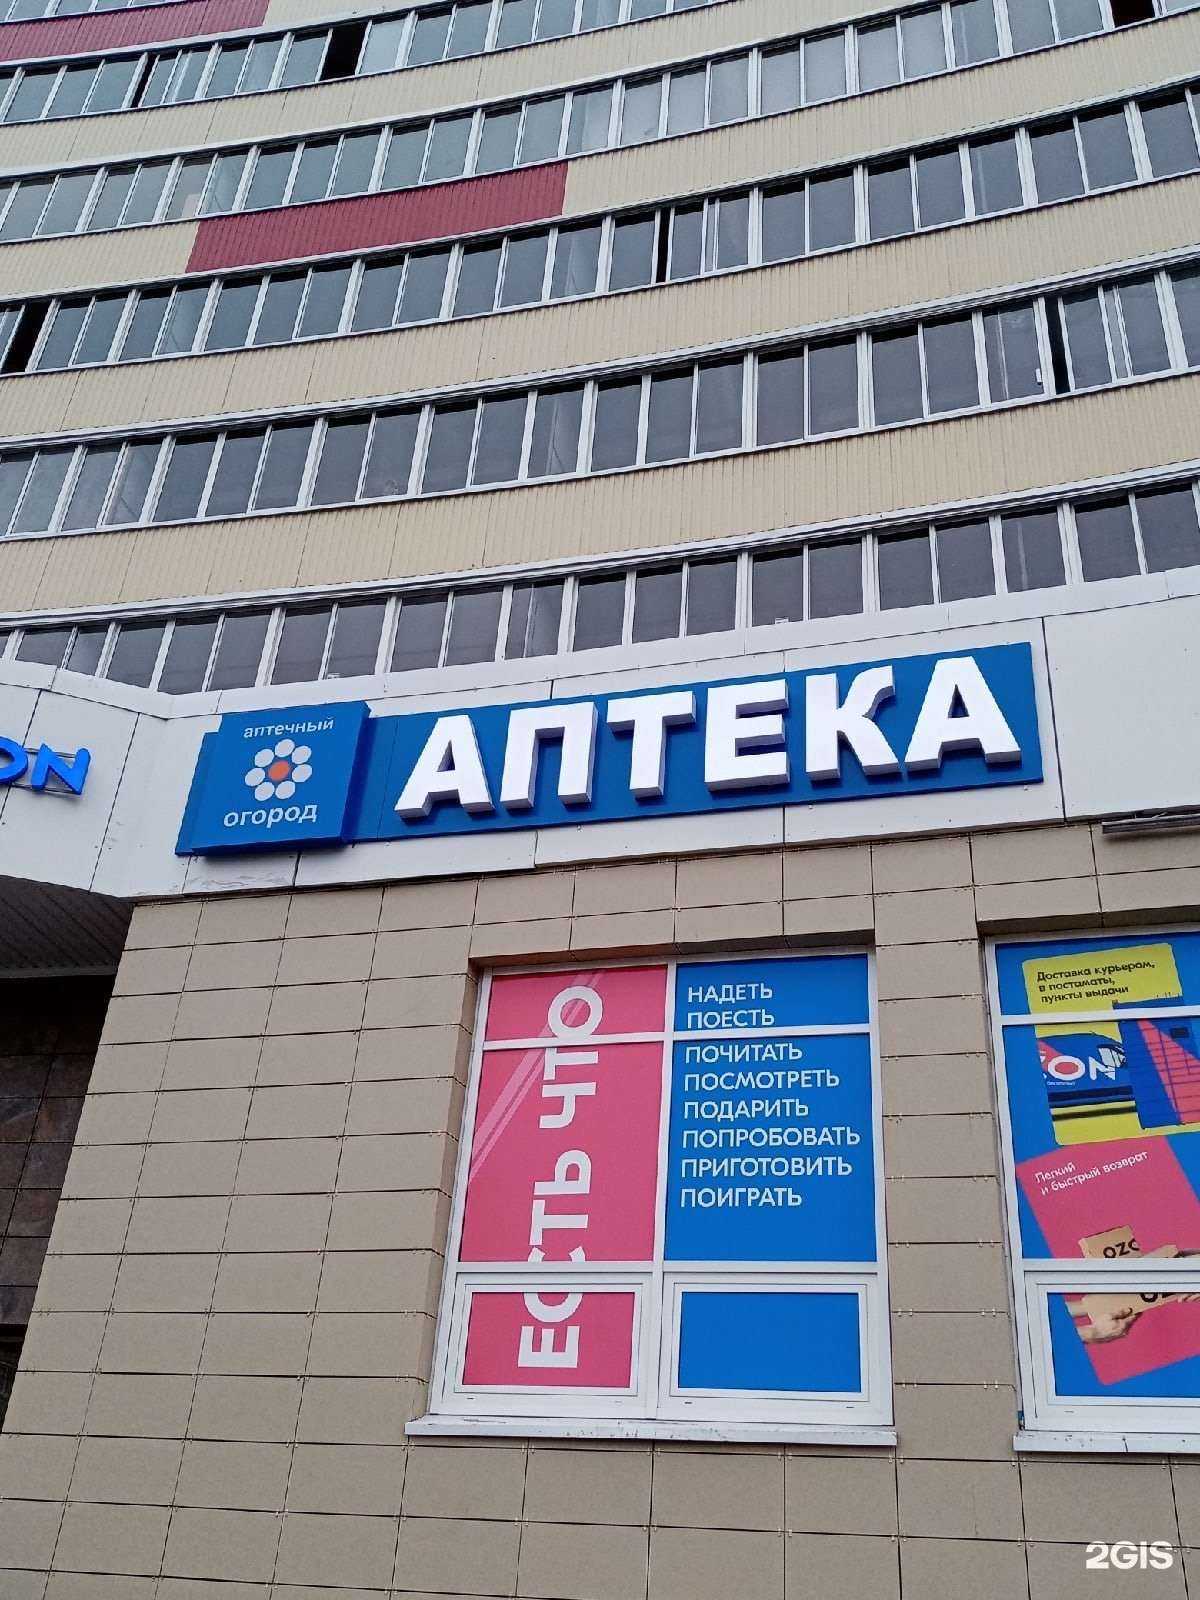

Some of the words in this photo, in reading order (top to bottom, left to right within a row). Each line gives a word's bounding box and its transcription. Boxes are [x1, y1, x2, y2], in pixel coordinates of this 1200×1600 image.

[243, 716, 335, 739] аптечный
[394, 656, 1022, 819] АПТЕКА
[223, 803, 318, 828] огород
[1037, 968, 1092, 982] Доставка
[1038, 984, 1046, 993] в
[1048, 977, 1116, 992] постаматы,
[687, 983, 773, 1004] НАДЕТЬ
[1041, 991, 1083, 1005] пункты
[1085, 986, 1129, 998] выдачи
[686, 1009, 776, 1029] ПОЕСТЬ
[539, 985, 604, 1129] ЧТО
[684, 1043, 803, 1064] ПОЧИТАТЬ
[1040, 1053, 1116, 1081] ON
[683, 1069, 840, 1092] ПОСМОТРЕТЬ
[683, 1099, 810, 1122] ПОДАРИТЬ
[682, 1127, 861, 1149] ПОПРОБОВАТЬ
[680, 1156, 853, 1178] ПРИГОТОВИТЬ
[1041, 1186, 1049, 1196] и
[1051, 1166, 1101, 1191] быстрый
[1102, 1151, 1149, 1168] возврат
[680, 1187, 803, 1208] ПОИГРАТЬ
